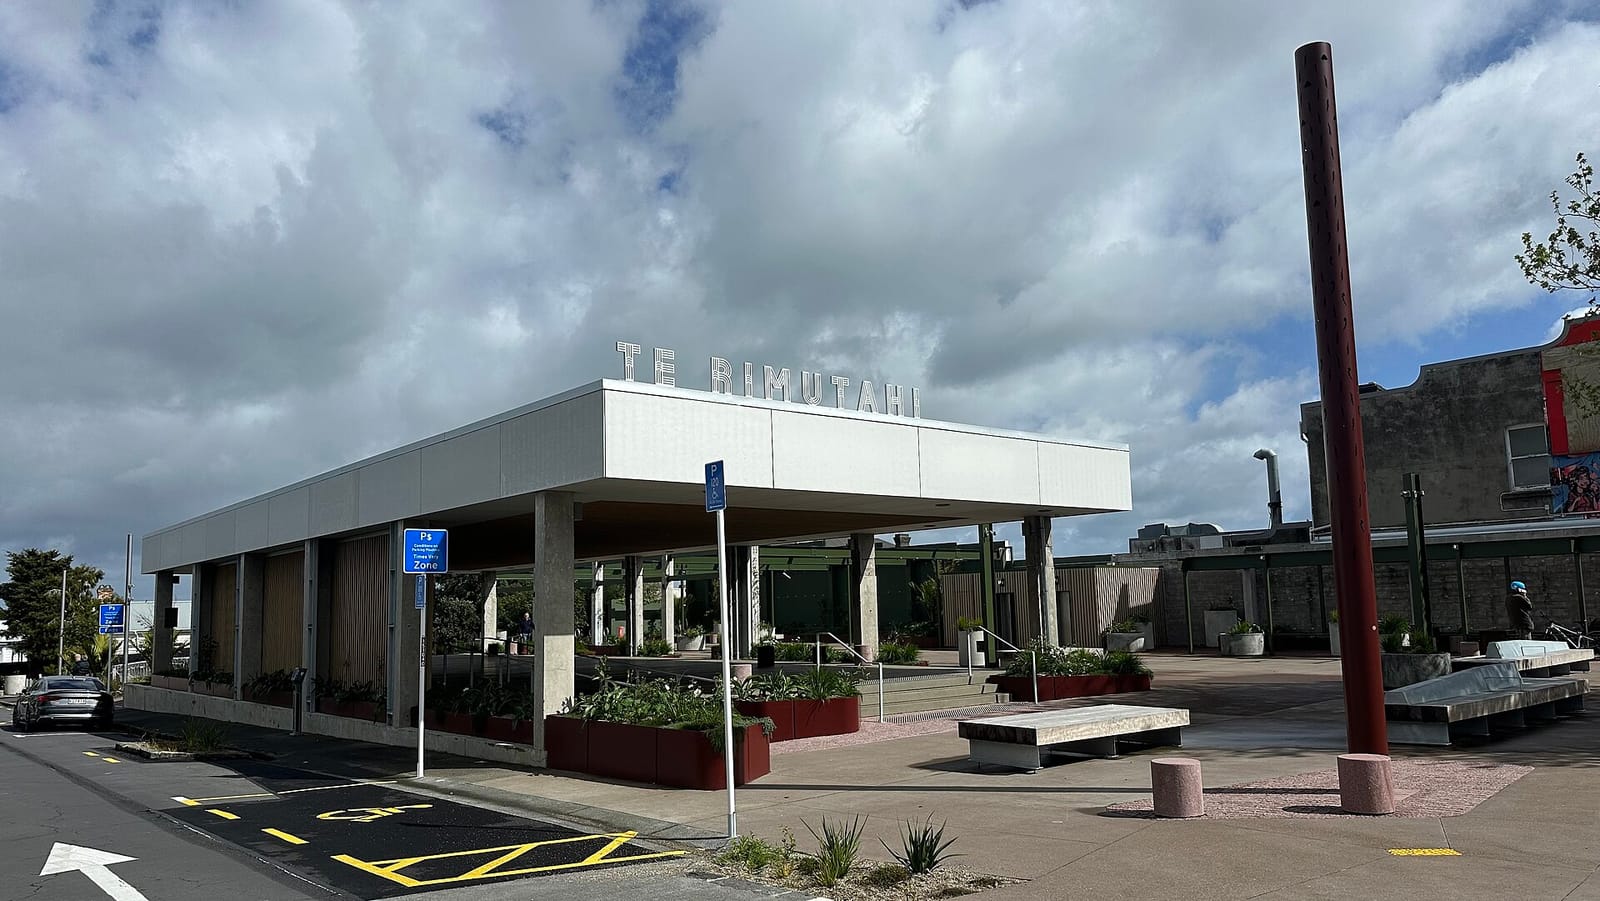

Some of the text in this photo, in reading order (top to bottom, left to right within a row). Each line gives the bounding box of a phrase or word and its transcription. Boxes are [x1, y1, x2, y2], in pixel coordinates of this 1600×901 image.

[615, 341, 921, 419] TE RIMUTAHI
[711, 464, 718, 477] P
[413, 561, 438, 570] Zone
